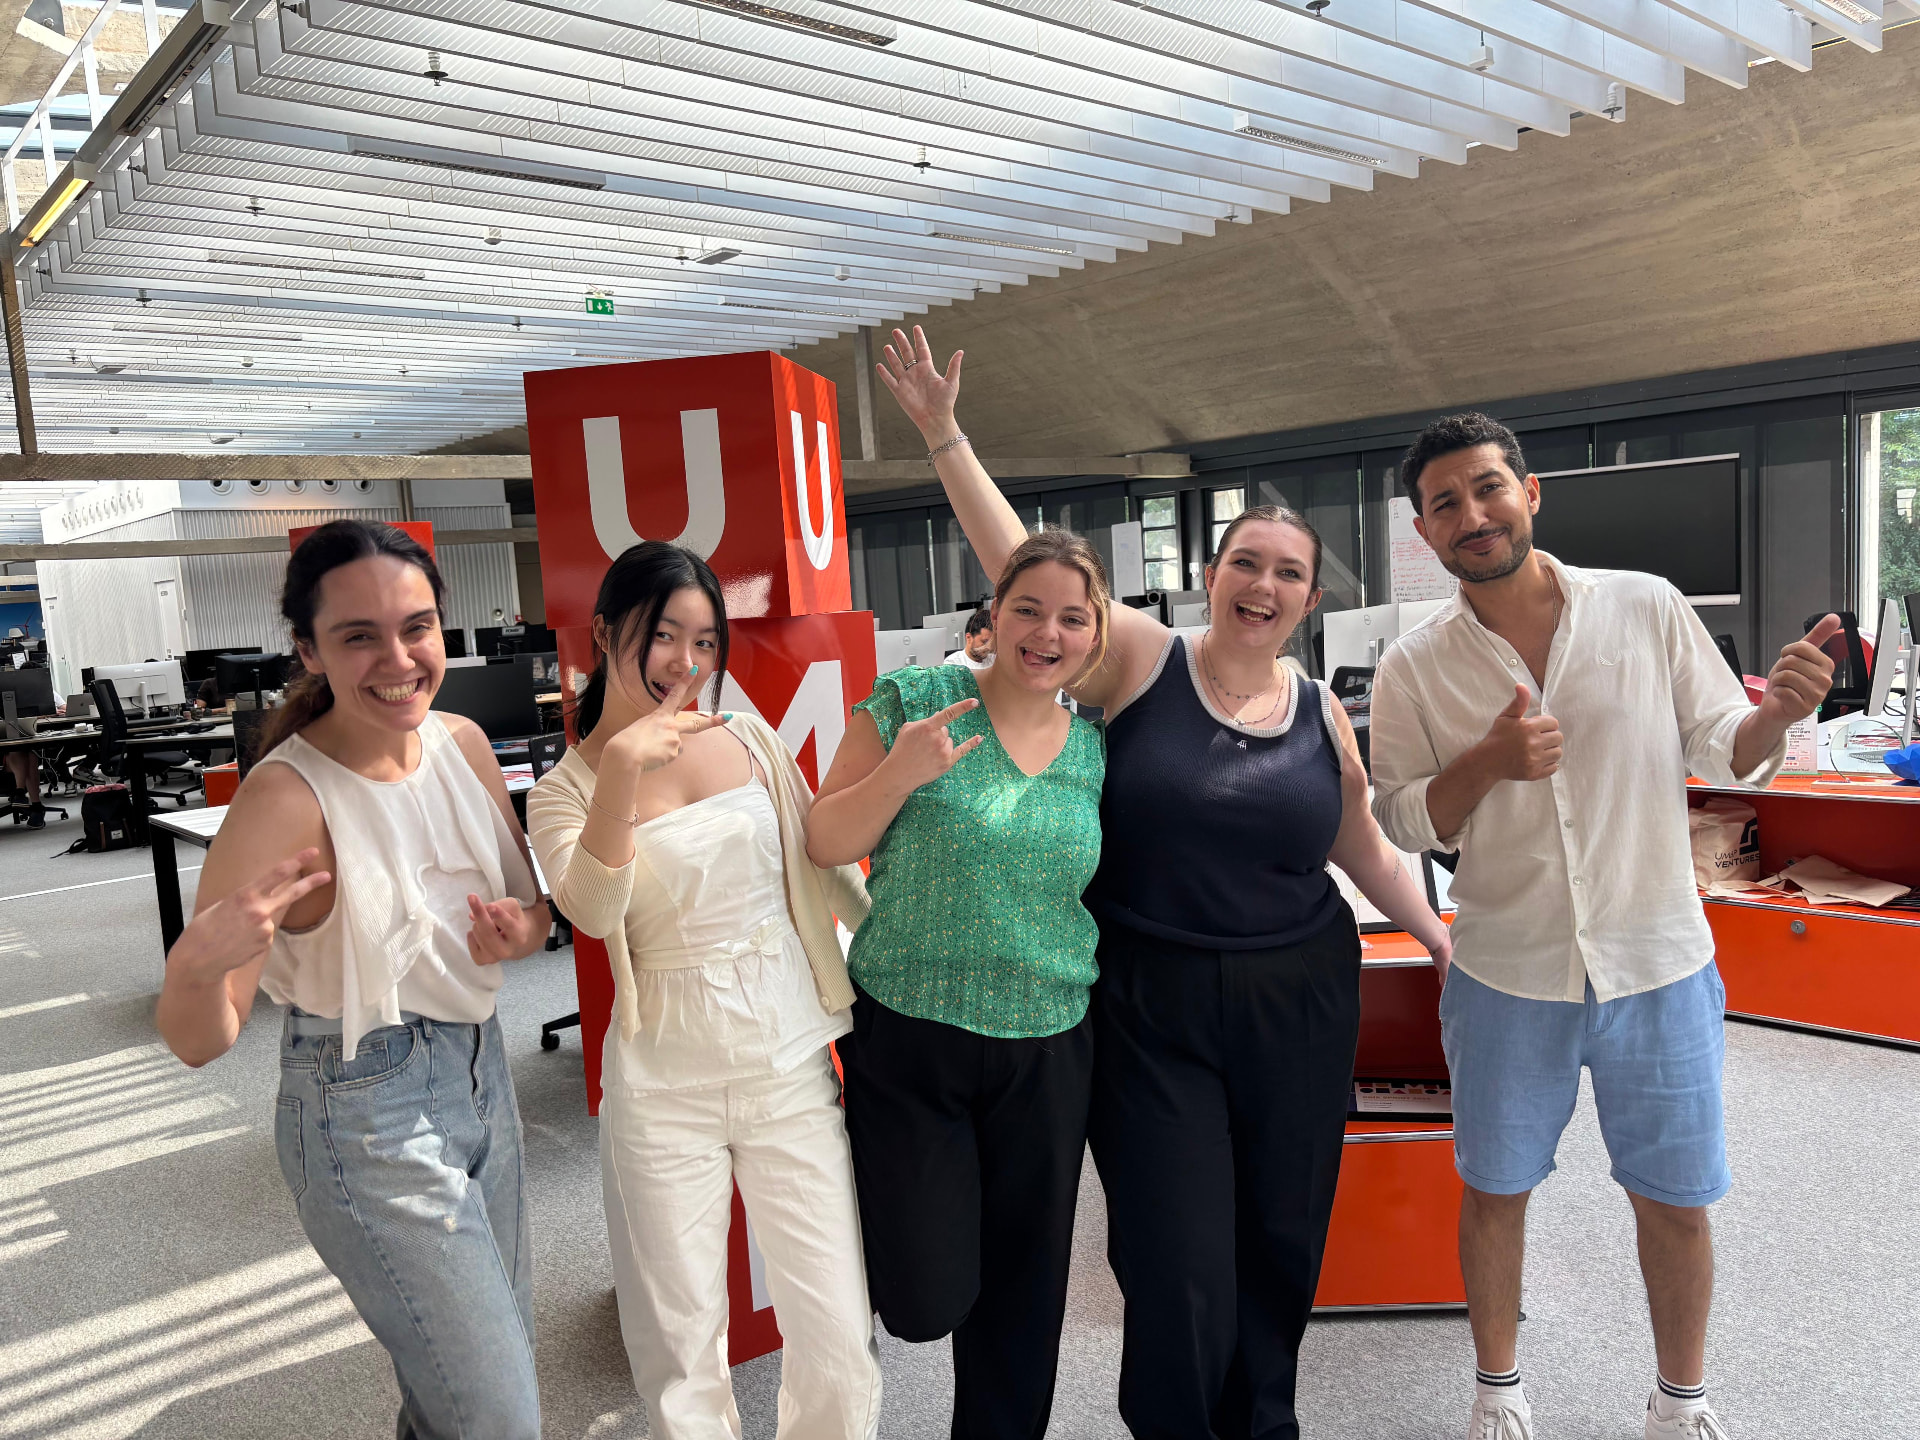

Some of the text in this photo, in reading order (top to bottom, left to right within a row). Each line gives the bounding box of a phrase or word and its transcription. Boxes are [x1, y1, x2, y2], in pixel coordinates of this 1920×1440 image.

[582, 407, 726, 564] U
[790, 410, 834, 571] U
[1714, 853, 1760, 868] VENTURES
